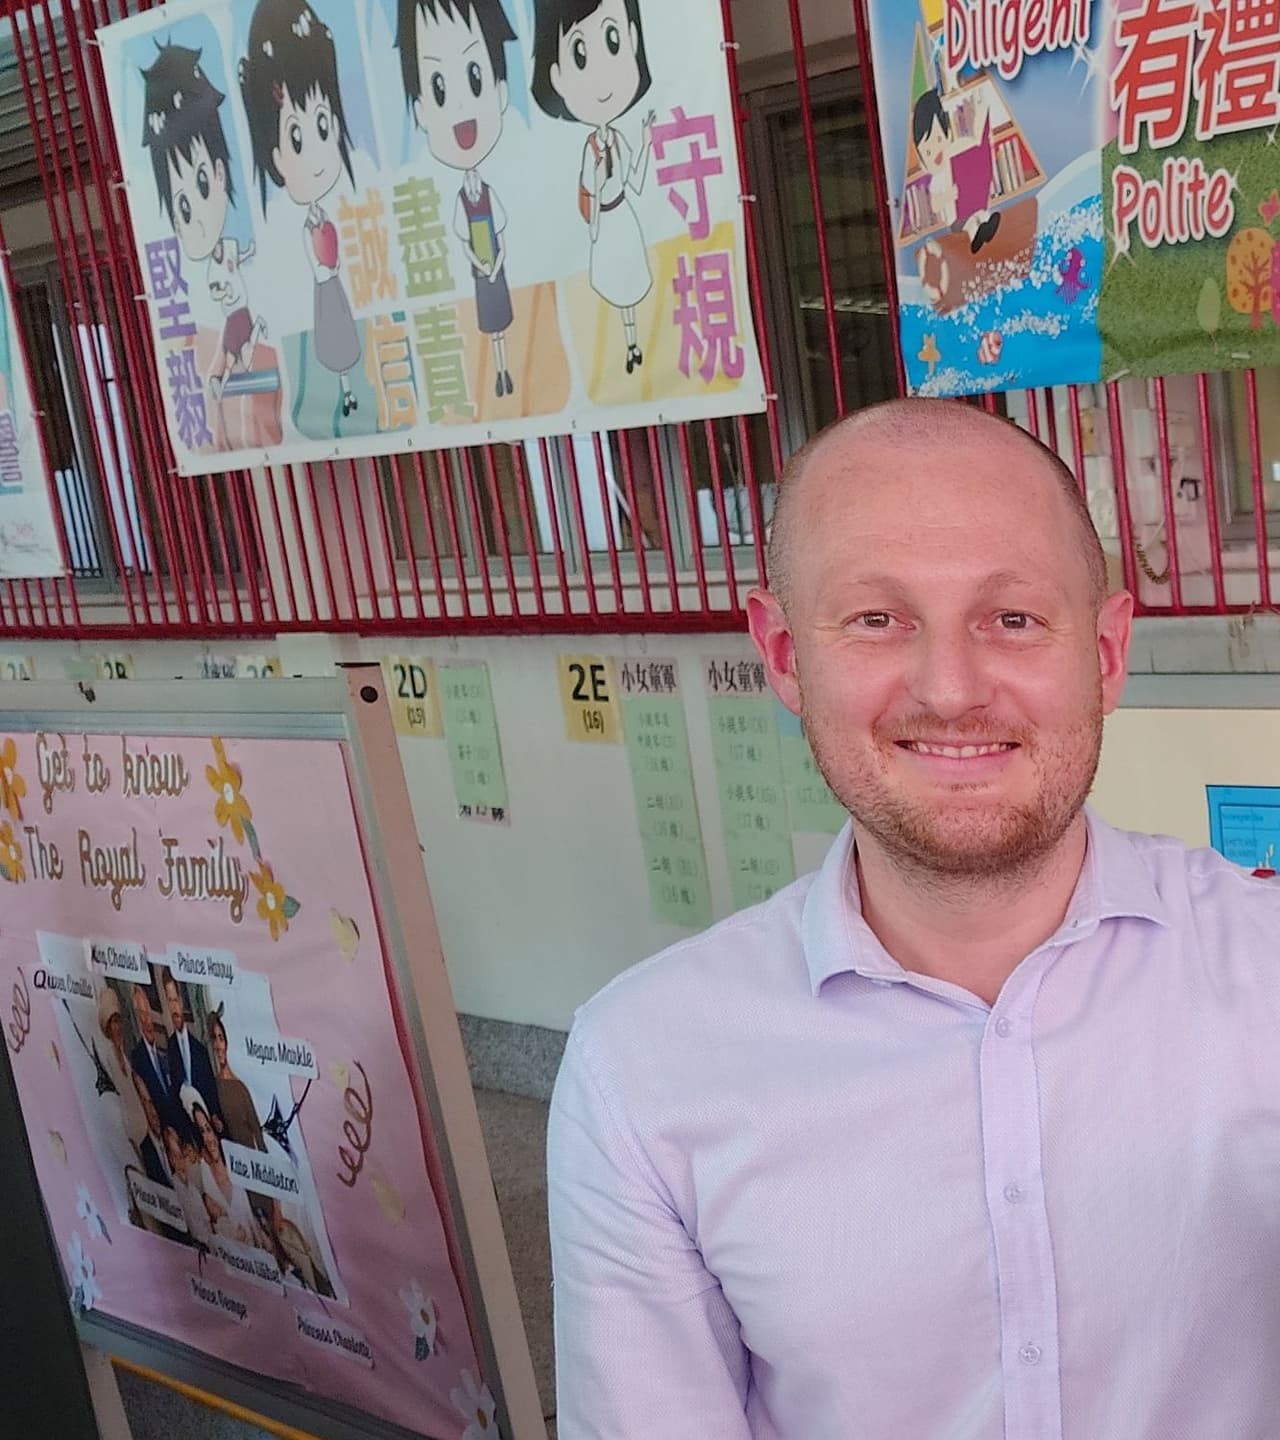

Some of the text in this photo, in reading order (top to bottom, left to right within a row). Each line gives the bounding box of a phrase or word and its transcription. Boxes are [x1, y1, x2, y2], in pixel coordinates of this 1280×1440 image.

[945, 0, 1089, 76] Diligent
[650, 106, 745, 383] 守規
[1116, 166, 1232, 247] Polite
[338, 187, 418, 430] 誠信
[392, 176, 477, 424] 盡責
[144, 236, 214, 450] 堅毅
[394, 664, 427, 699] 2D
[569, 664, 609, 702] 2E
[36, 732, 189, 814] Get to know
[24, 826, 63, 881] The
[78, 827, 146, 912] Royal
[177, 951, 234, 984] Prince Harry
[245, 1036, 313, 1068] Megan Markle
[251, 1160, 299, 1194] Middleton
